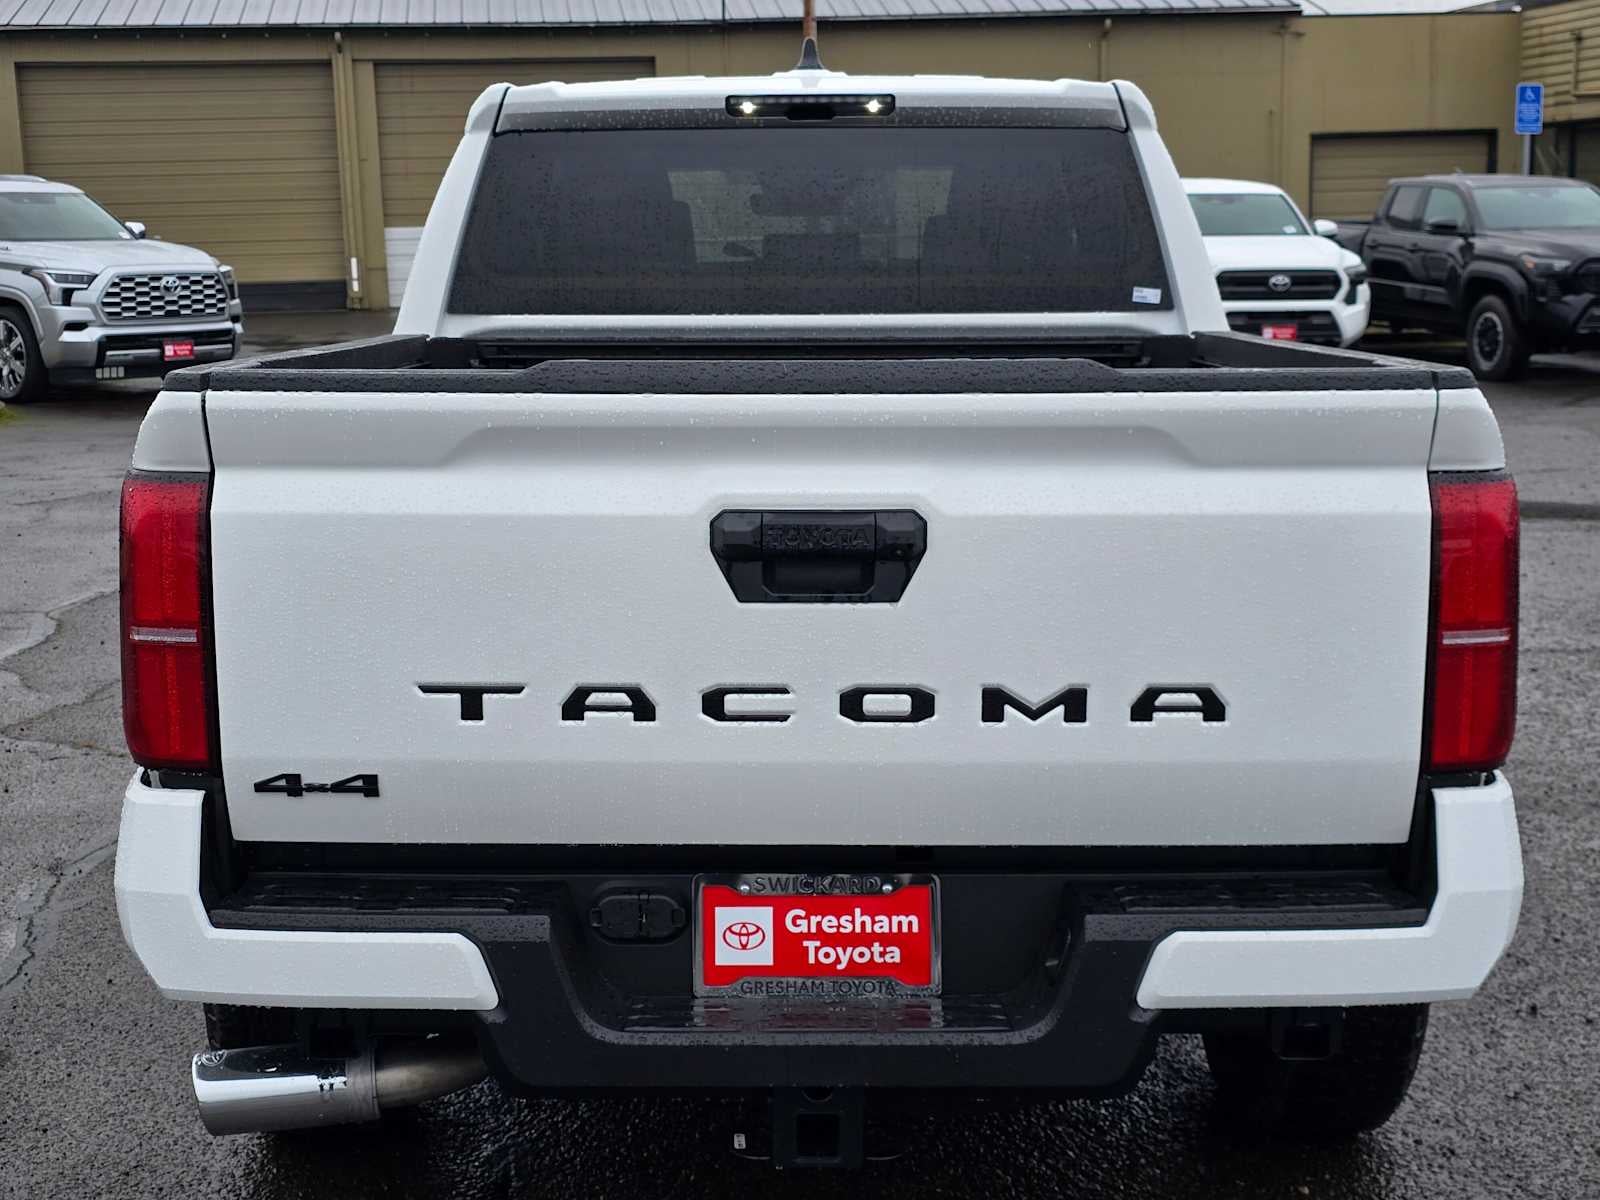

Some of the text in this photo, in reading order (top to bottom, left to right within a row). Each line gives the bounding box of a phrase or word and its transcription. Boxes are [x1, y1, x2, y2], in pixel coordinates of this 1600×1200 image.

[767, 526, 870, 547] TOYOTA
[417, 685, 1226, 722] TACOMA
[754, 876, 882, 895] SWICKARD
[785, 907, 919, 934] Gresham
[803, 940, 901, 970] Toyota
[740, 980, 898, 996] GRESHAM TOYOTA
